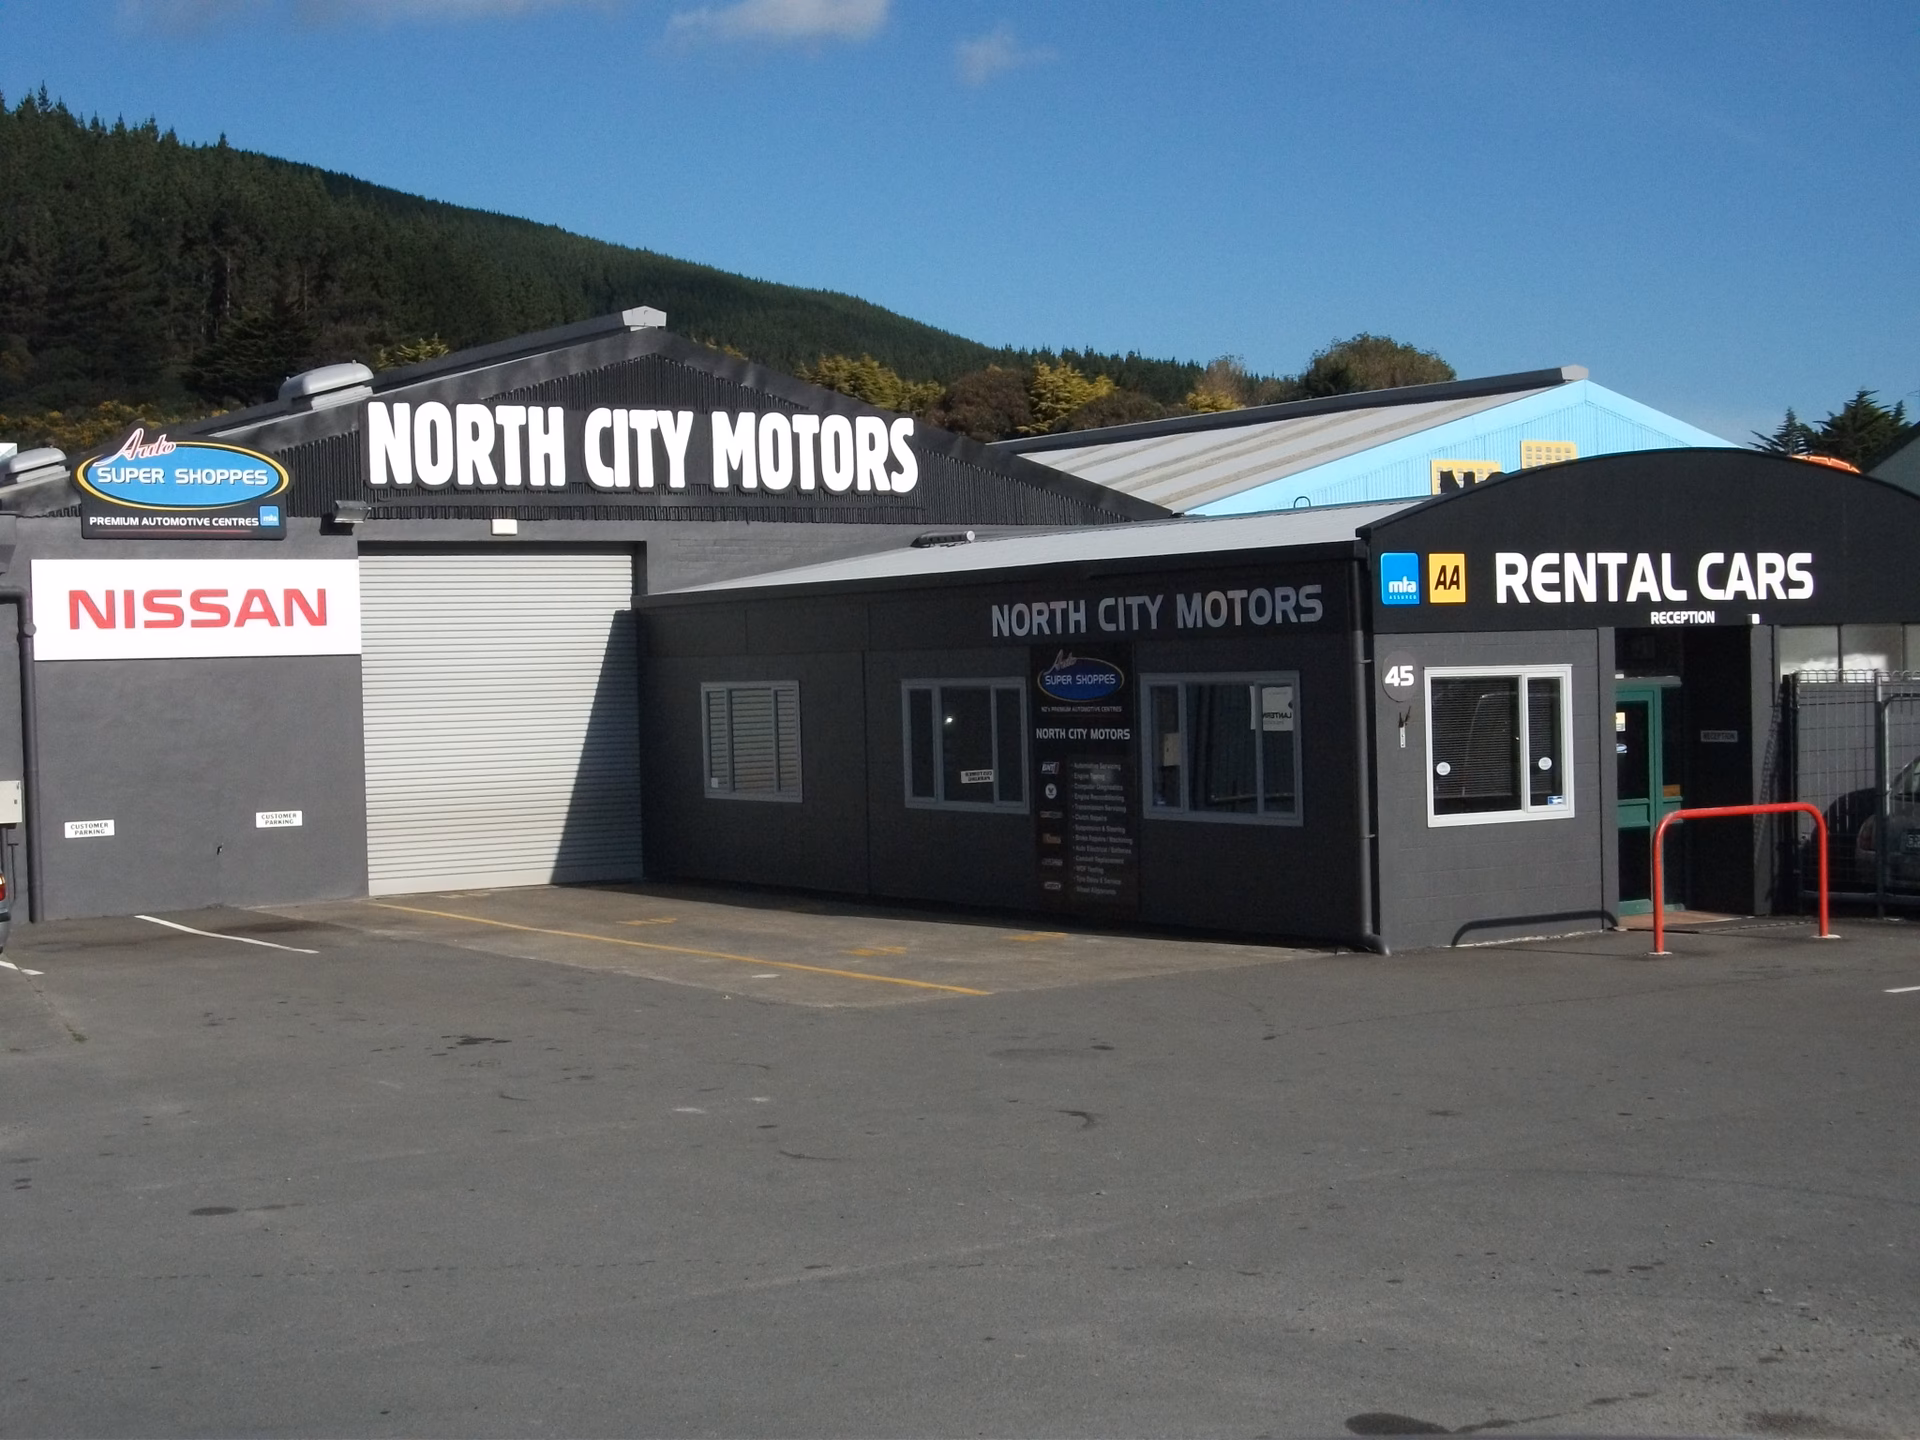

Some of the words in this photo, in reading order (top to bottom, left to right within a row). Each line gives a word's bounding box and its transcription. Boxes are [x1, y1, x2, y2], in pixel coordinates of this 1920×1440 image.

[92, 428, 177, 467] Auto
[368, 401, 566, 486] NORTH
[584, 407, 693, 489] CITY
[711, 412, 918, 493] MOTORS
[97, 468, 165, 485] SUPER
[175, 469, 268, 486] SHOPPES
[89, 516, 139, 526] PREMIUM
[141, 516, 211, 527] AUTOMOTIVE
[212, 517, 260, 527] CENTRES
[1388, 575, 1417, 593] mta
[1434, 565, 1460, 590] AA
[1495, 552, 1687, 604] RENTAL
[1698, 552, 1814, 601] CARS
[68, 588, 327, 630] NISSAN
[991, 600, 1087, 637] NORTH
[1098, 595, 1164, 631] CITY
[1176, 584, 1324, 629] MOTORS
[1650, 610, 1715, 625] RECEPTION
[1045, 675, 1073, 685] SUPER
[1076, 674, 1116, 685] SHOPPES
[1385, 665, 1415, 688] 45
[1036, 728, 1065, 739] NORTH
[1069, 728, 1087, 739] CITY
[1091, 728, 1130, 740] MOTORS
[70, 822, 109, 830] CUSTOMER
